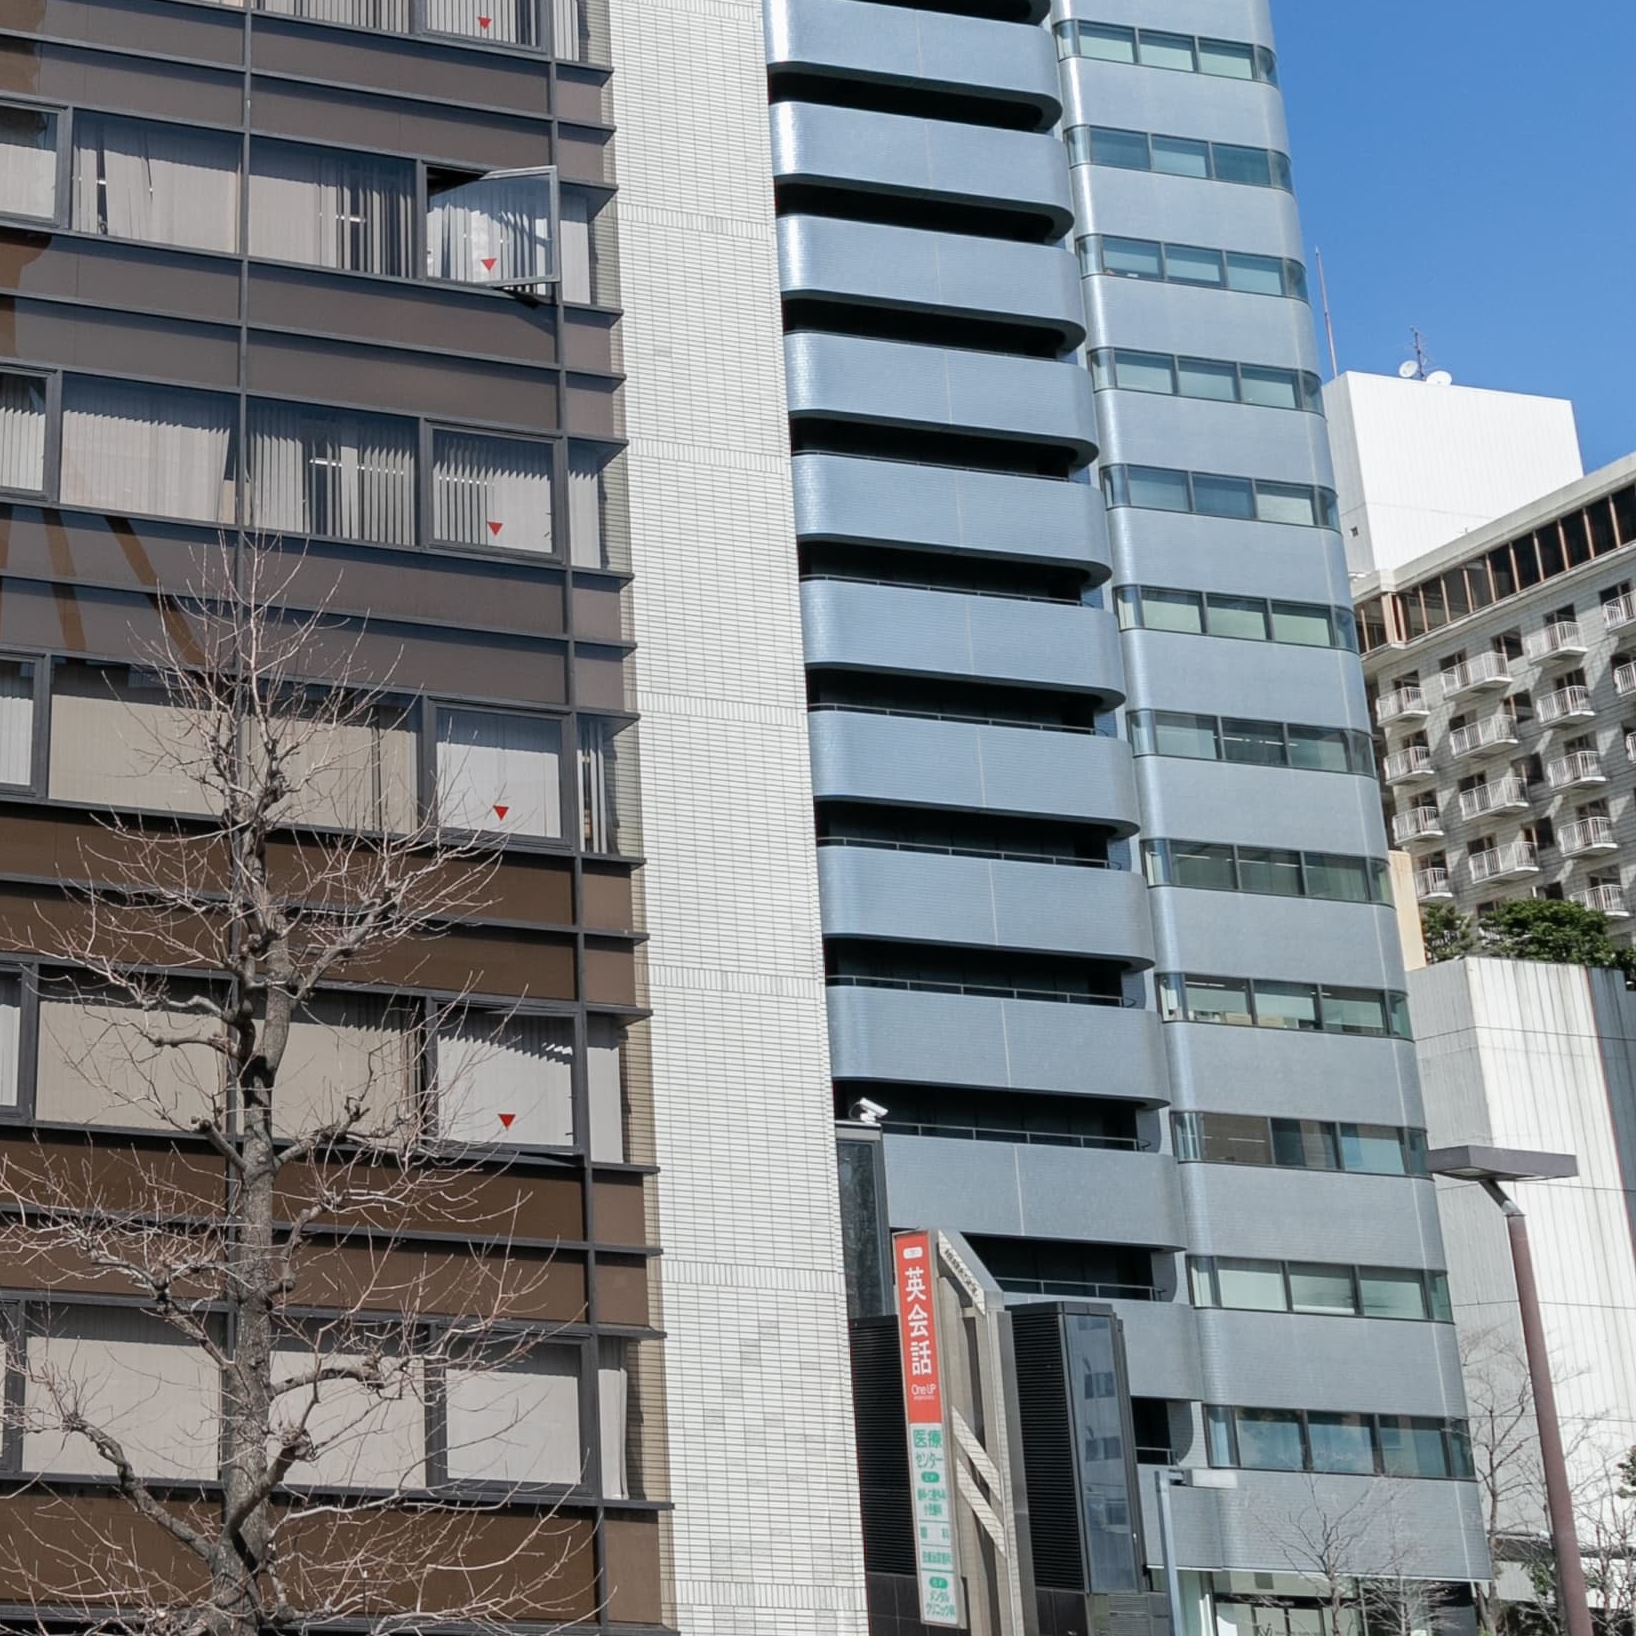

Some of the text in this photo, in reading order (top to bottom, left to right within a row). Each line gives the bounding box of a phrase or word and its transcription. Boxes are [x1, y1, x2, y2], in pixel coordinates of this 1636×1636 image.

[905, 1266, 932, 1376] 英会話
[913, 1429, 942, 1448] 医療
[915, 1451, 944, 1468] センター
